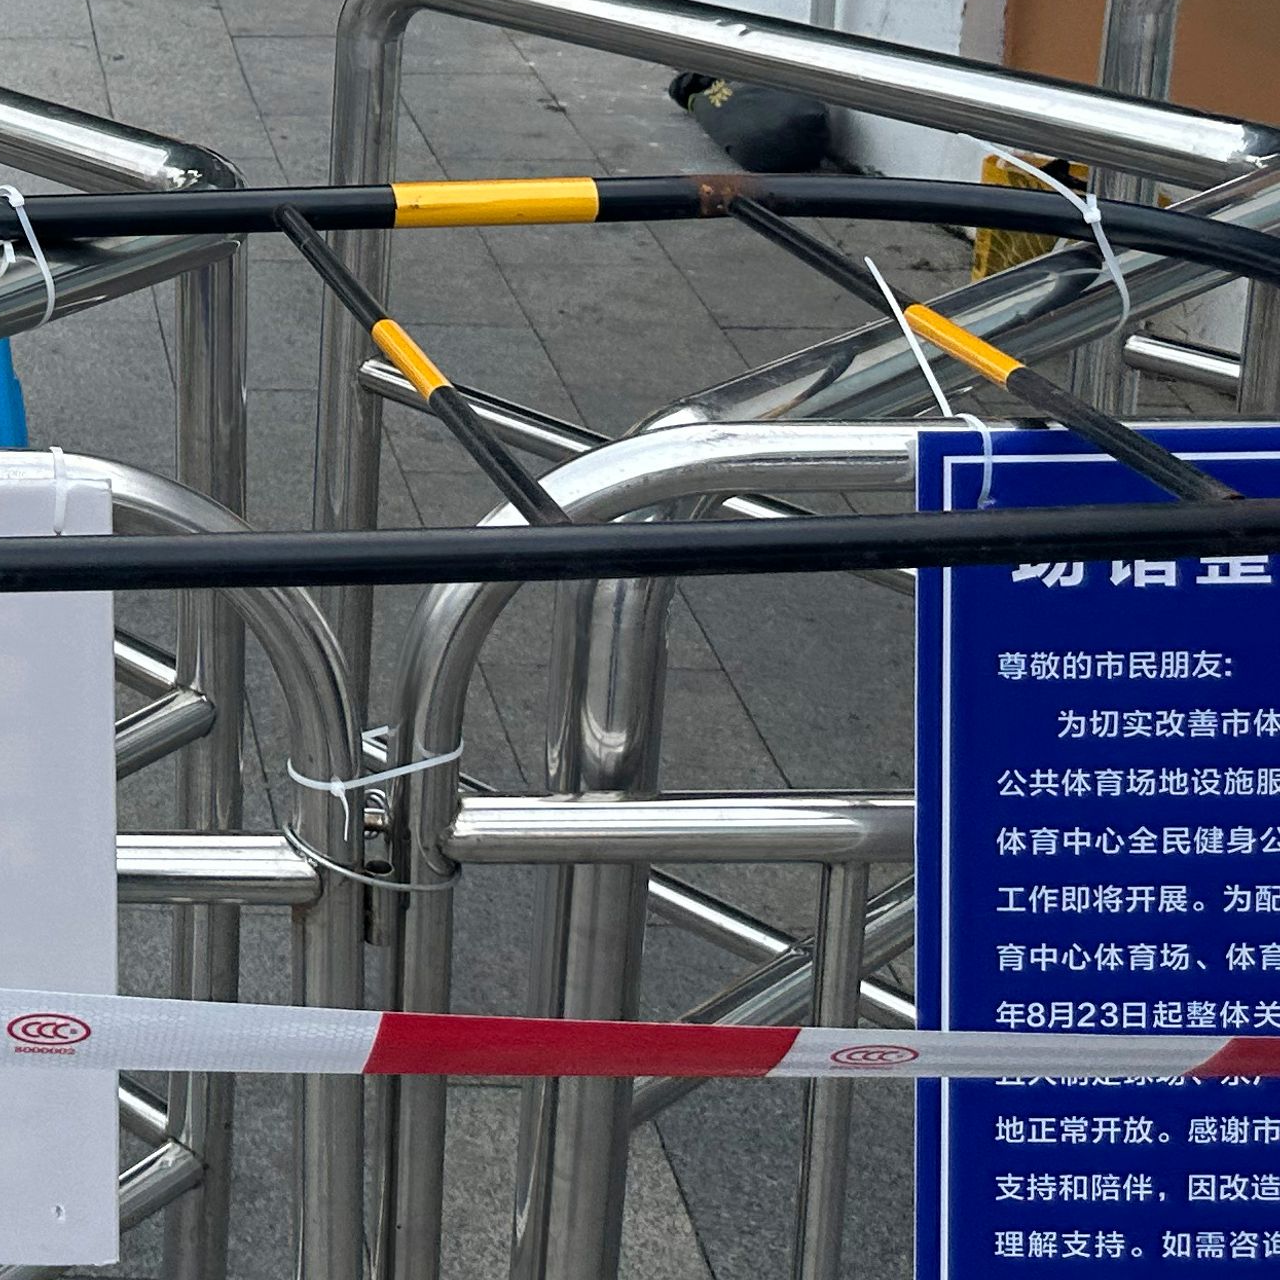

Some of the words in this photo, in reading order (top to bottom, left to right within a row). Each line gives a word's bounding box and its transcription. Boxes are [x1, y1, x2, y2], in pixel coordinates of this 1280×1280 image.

[997, 650, 1232, 679] 尊敬的市民朋友：
[1058, 708, 1280, 738] 为切实改善市体
[997, 767, 1280, 797] 公共体育场地设施服
[996, 884, 1280, 914] 工作即将开展。为配
[995, 1000, 1280, 1029] 年8月23日起整体关
[995, 1116, 1280, 1144] 地正常开放。感谢市
[995, 1173, 1280, 1202] 支持和陪伴，因改造
